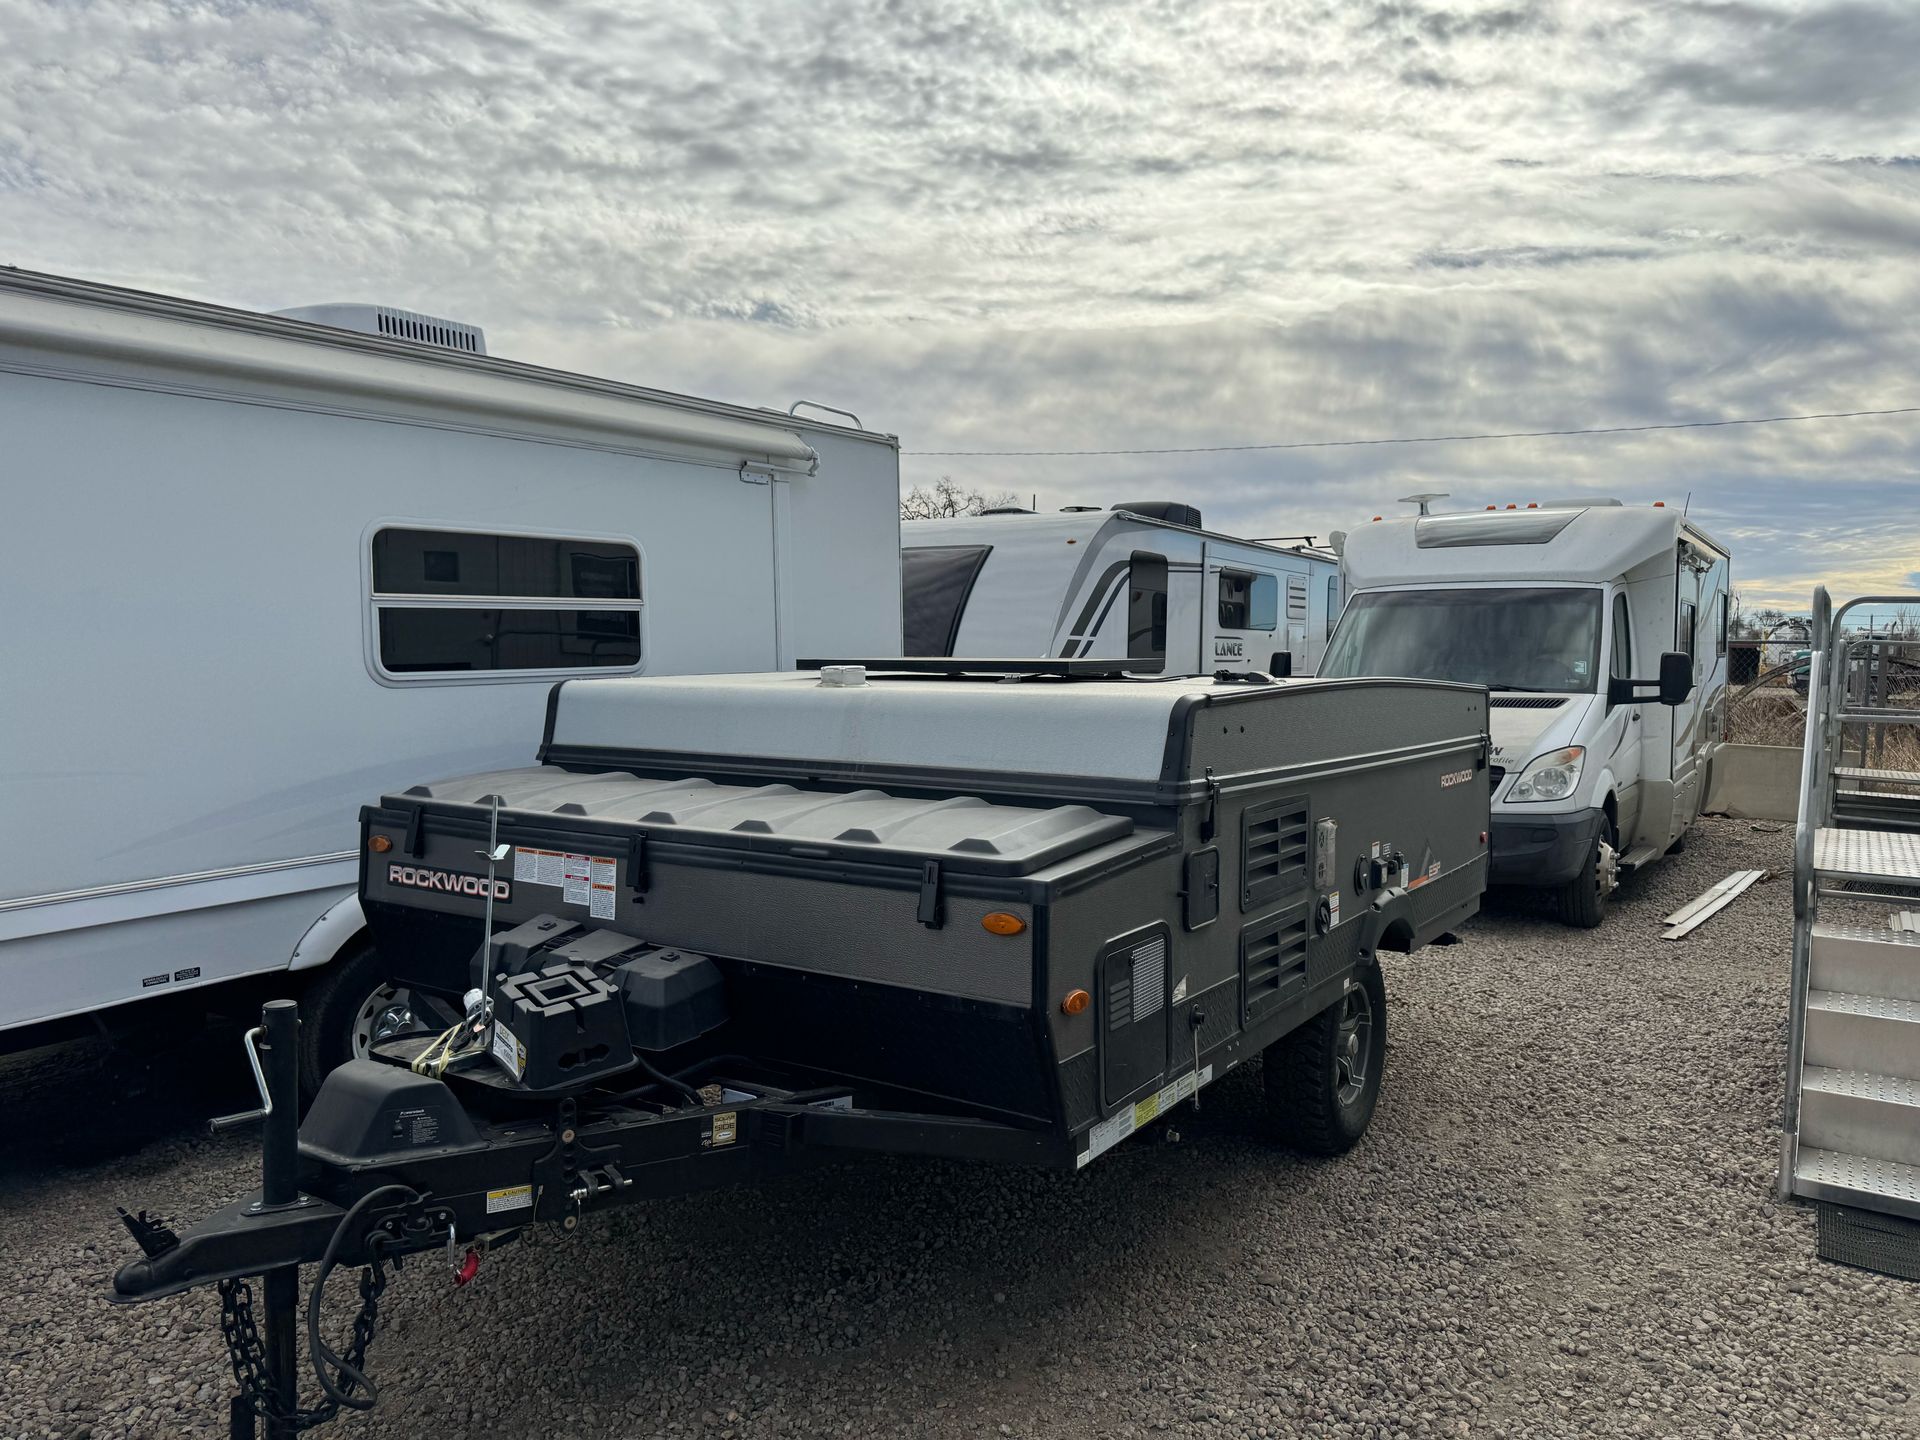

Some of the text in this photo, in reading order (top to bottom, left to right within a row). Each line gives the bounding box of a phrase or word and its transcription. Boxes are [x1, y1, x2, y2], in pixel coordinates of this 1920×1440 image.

[1215, 642, 1243, 657] LANCE
[1441, 769, 1472, 787] ROCKWOOD
[389, 864, 510, 899] ROCKWOOD
